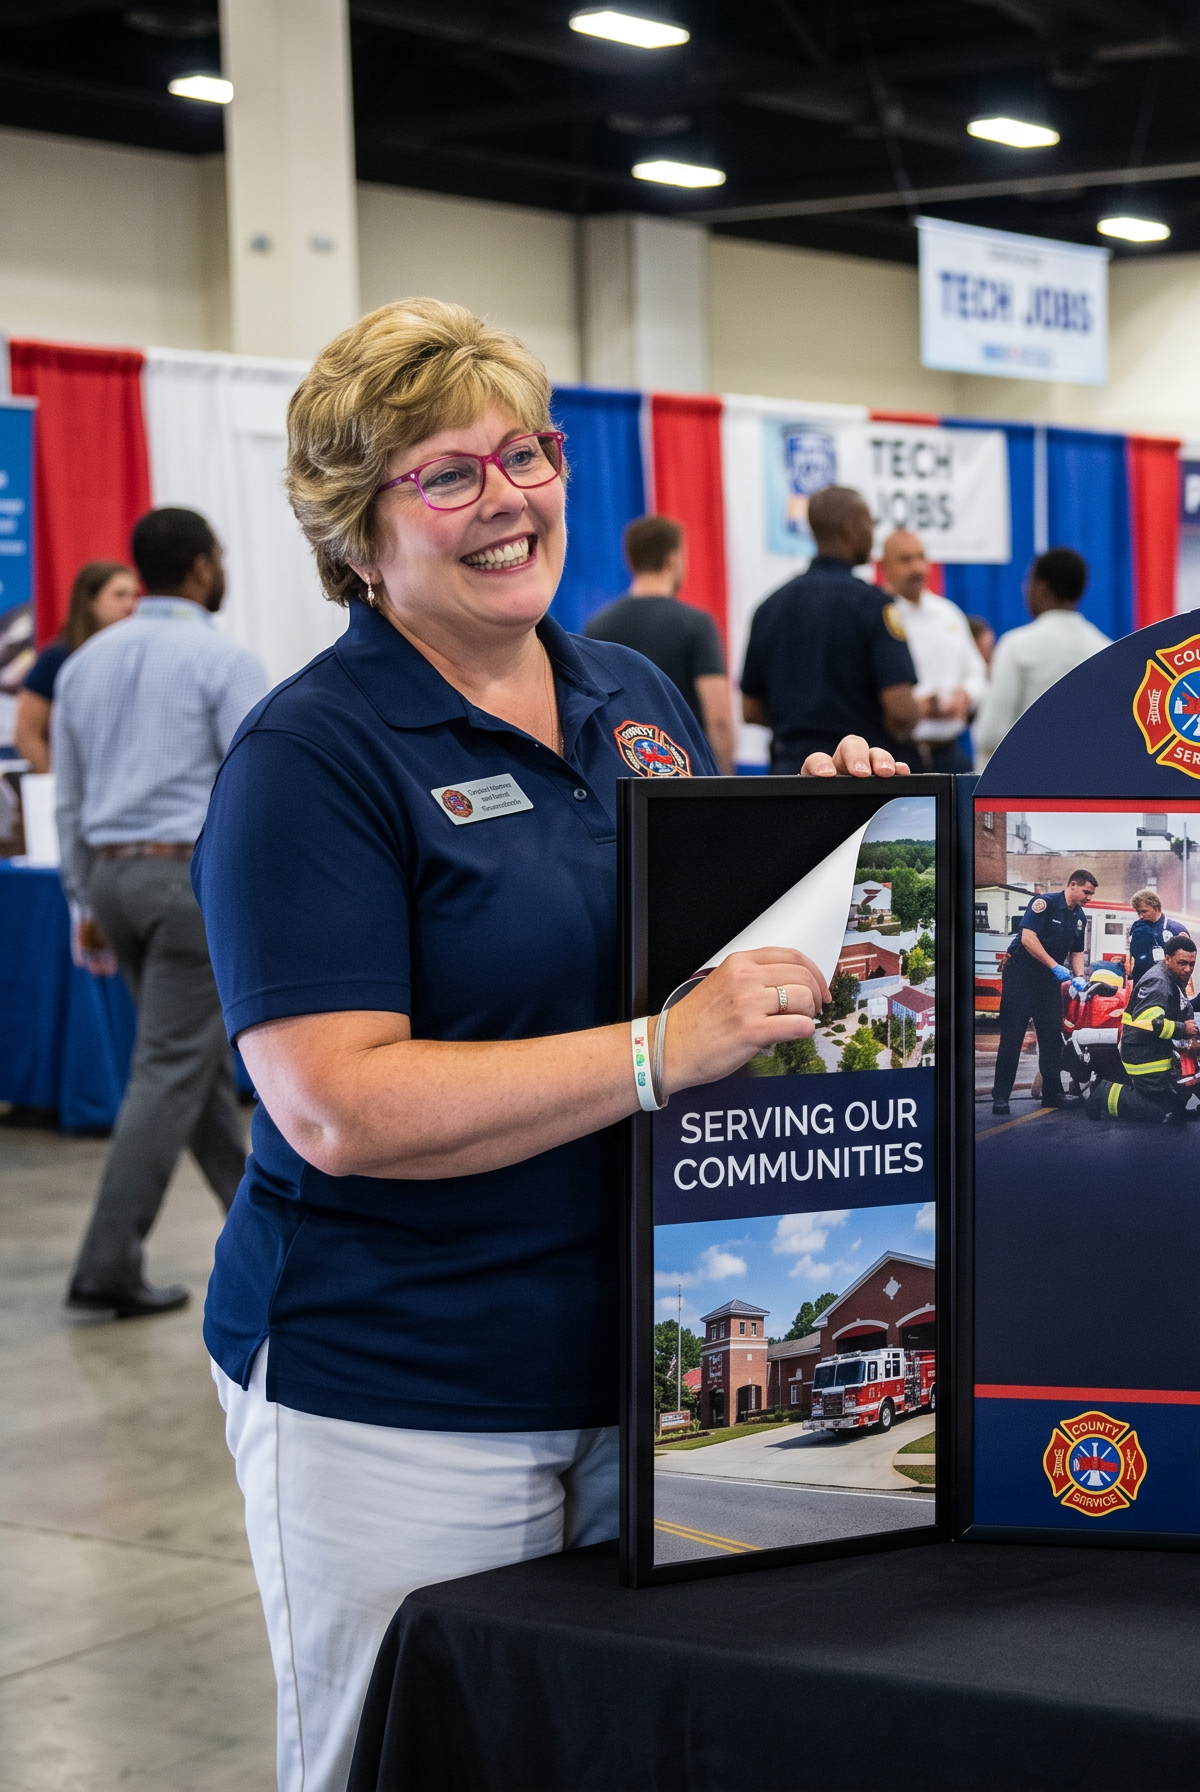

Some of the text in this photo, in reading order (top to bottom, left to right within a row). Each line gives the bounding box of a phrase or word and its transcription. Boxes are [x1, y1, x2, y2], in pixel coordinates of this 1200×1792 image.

[941, 271, 1093, 334] TECH JOBS
[870, 438, 953, 478] TECH
[870, 490, 953, 530] JOBS
[680, 1098, 918, 1144] SERVING OUR
[673, 1142, 924, 1191] COMMUNITIES
[1072, 1421, 1119, 1436] COUNTY
